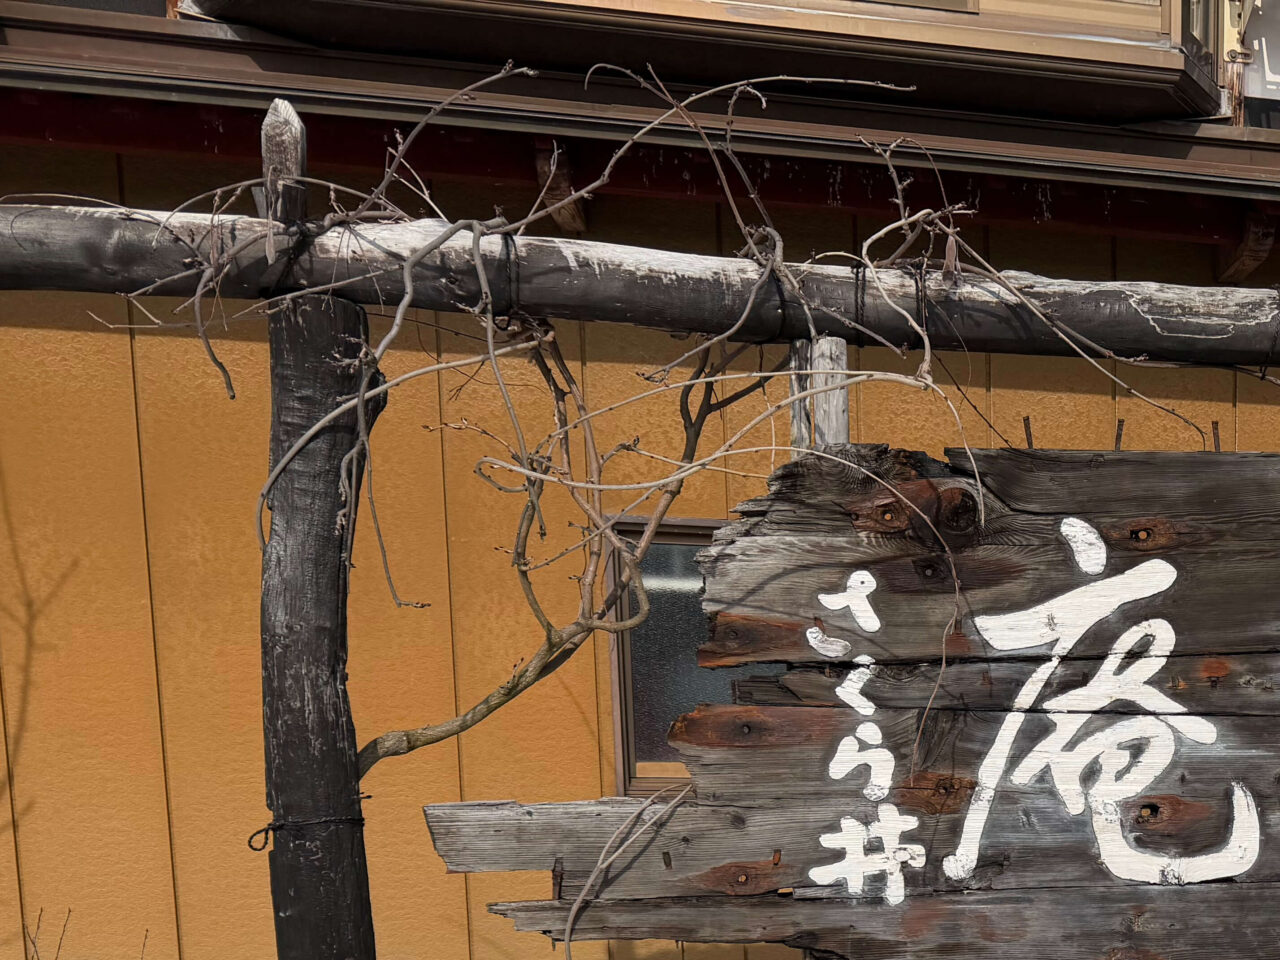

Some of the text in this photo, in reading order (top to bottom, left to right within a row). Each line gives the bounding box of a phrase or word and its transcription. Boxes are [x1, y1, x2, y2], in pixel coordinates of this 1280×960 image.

[806, 570, 927, 906] さくら井
[942, 517, 1261, 886] 庵
